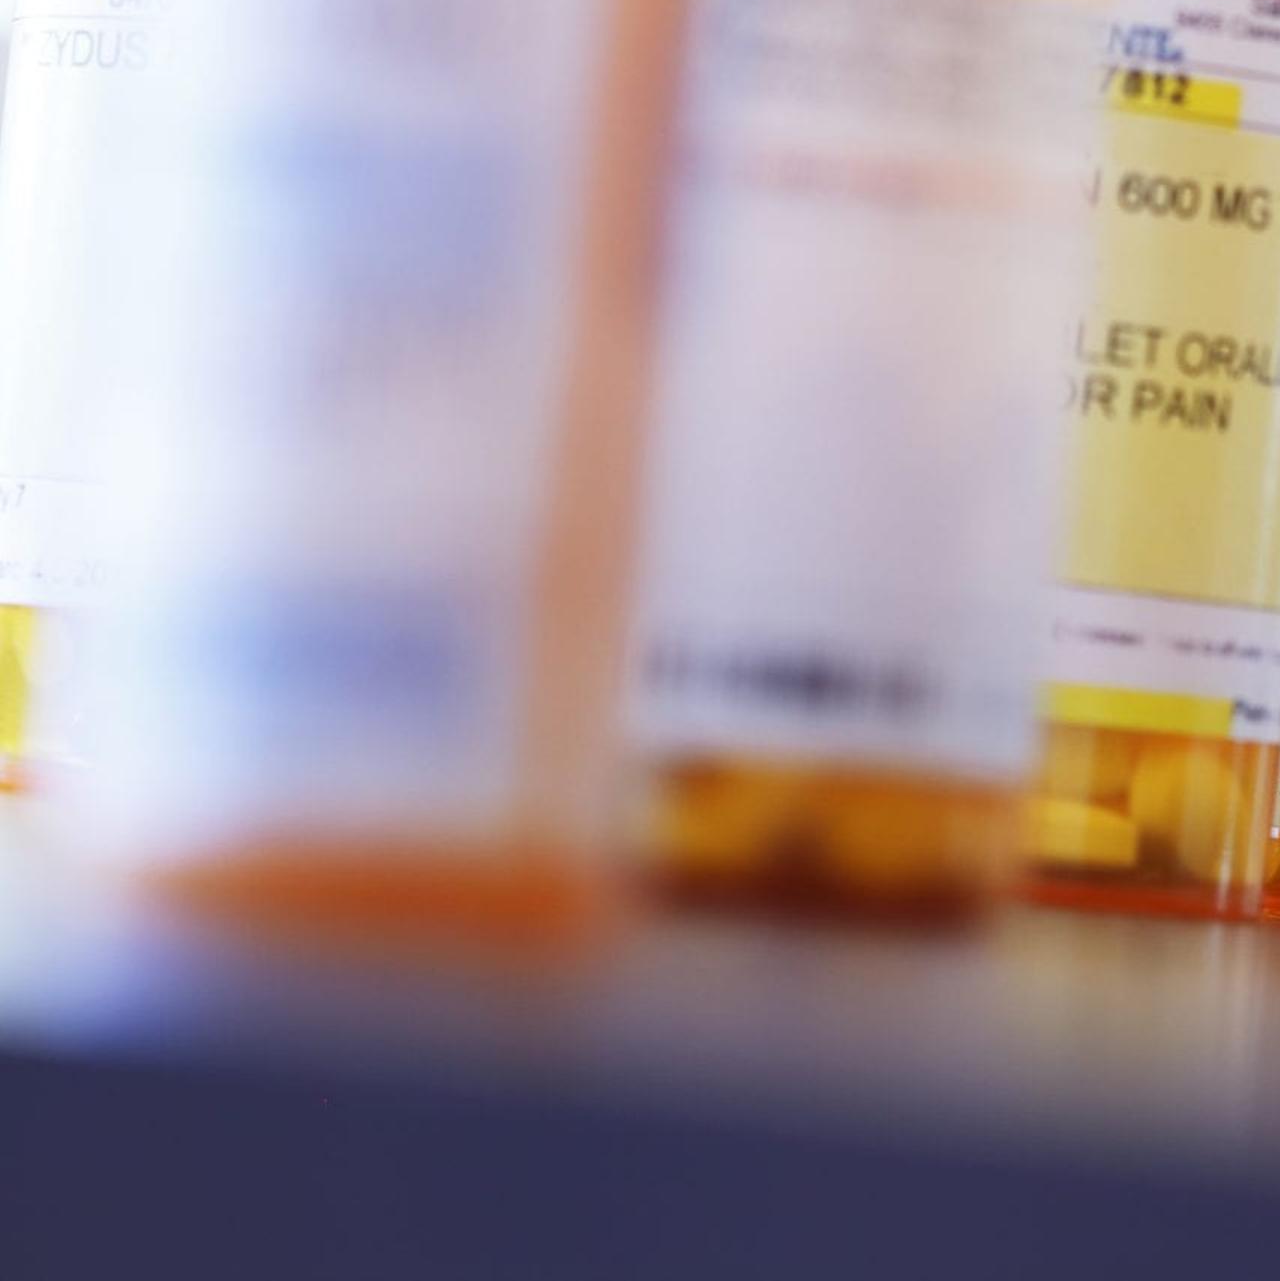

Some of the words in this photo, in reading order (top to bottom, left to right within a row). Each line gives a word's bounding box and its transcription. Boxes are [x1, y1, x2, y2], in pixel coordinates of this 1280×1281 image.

[1117, 172, 1201, 221] 600
[1212, 181, 1272, 231] MG
[1131, 376, 1233, 432] PAIN
